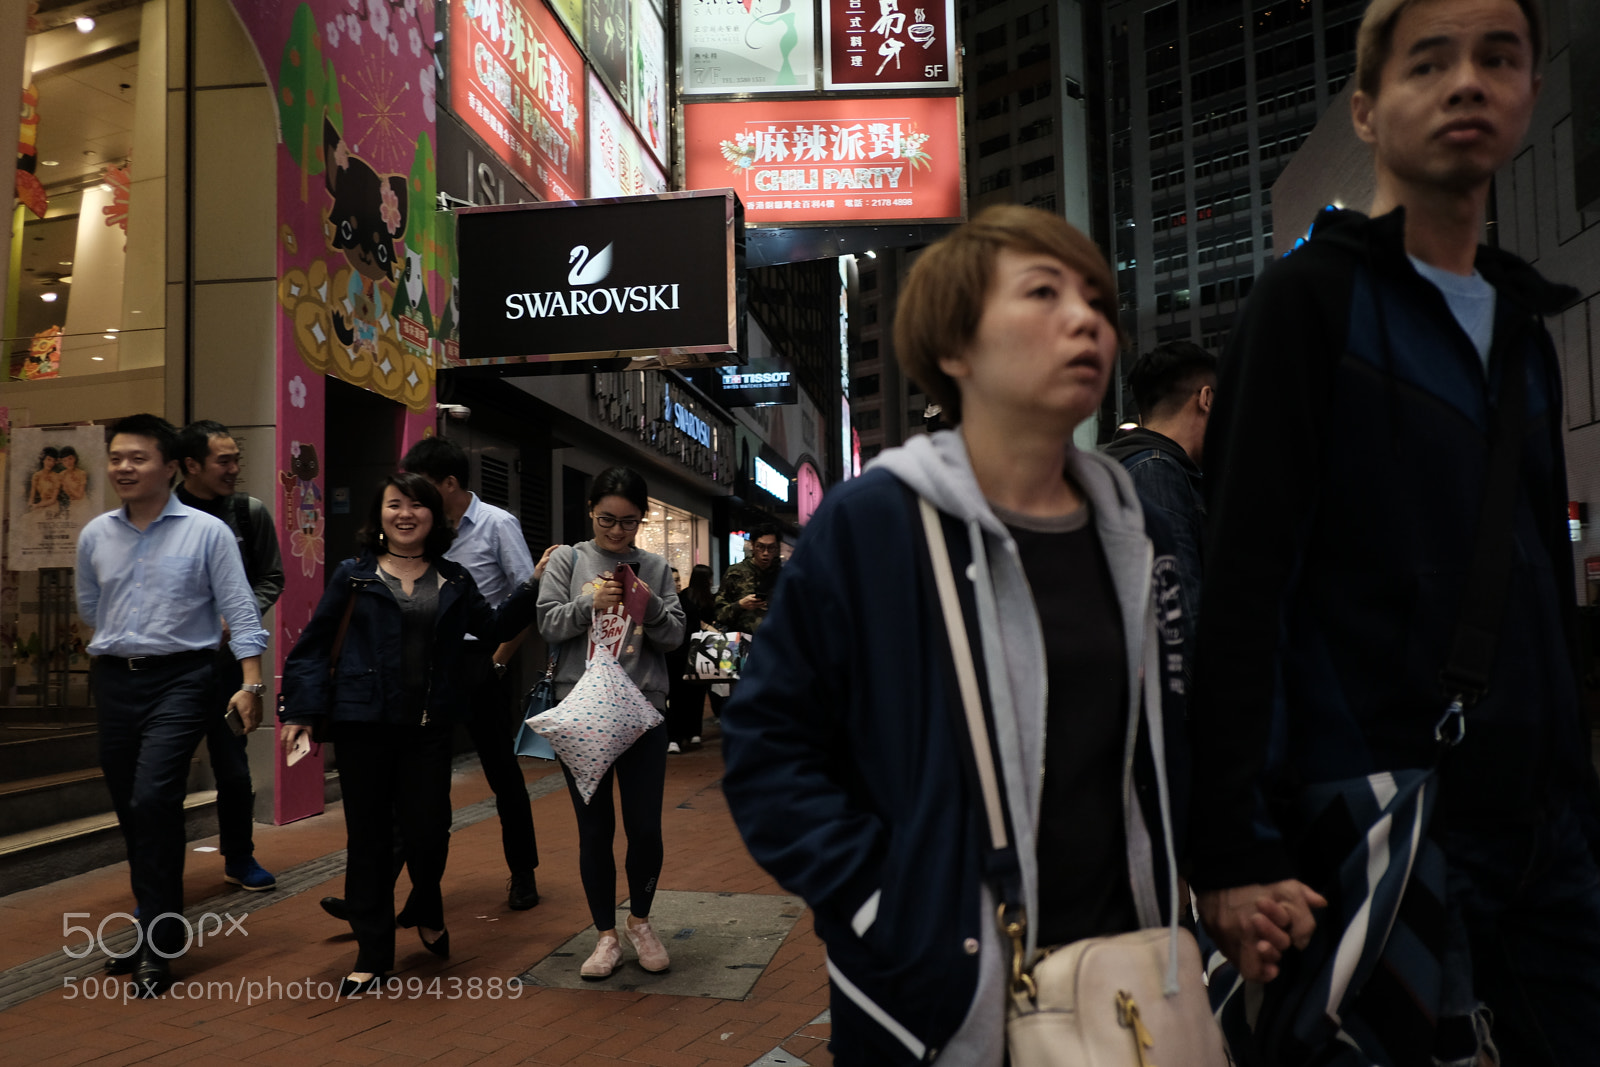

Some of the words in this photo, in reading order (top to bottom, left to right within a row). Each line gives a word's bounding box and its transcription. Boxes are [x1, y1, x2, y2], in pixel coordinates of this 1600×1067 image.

[924, 65, 944, 78] 5F
[754, 123, 904, 163] 麻辣派對
[754, 169, 819, 191] CHILI
[823, 167, 903, 189] PARTY
[505, 283, 680, 320] SWAROVSKI
[741, 372, 790, 384] TISSOT
